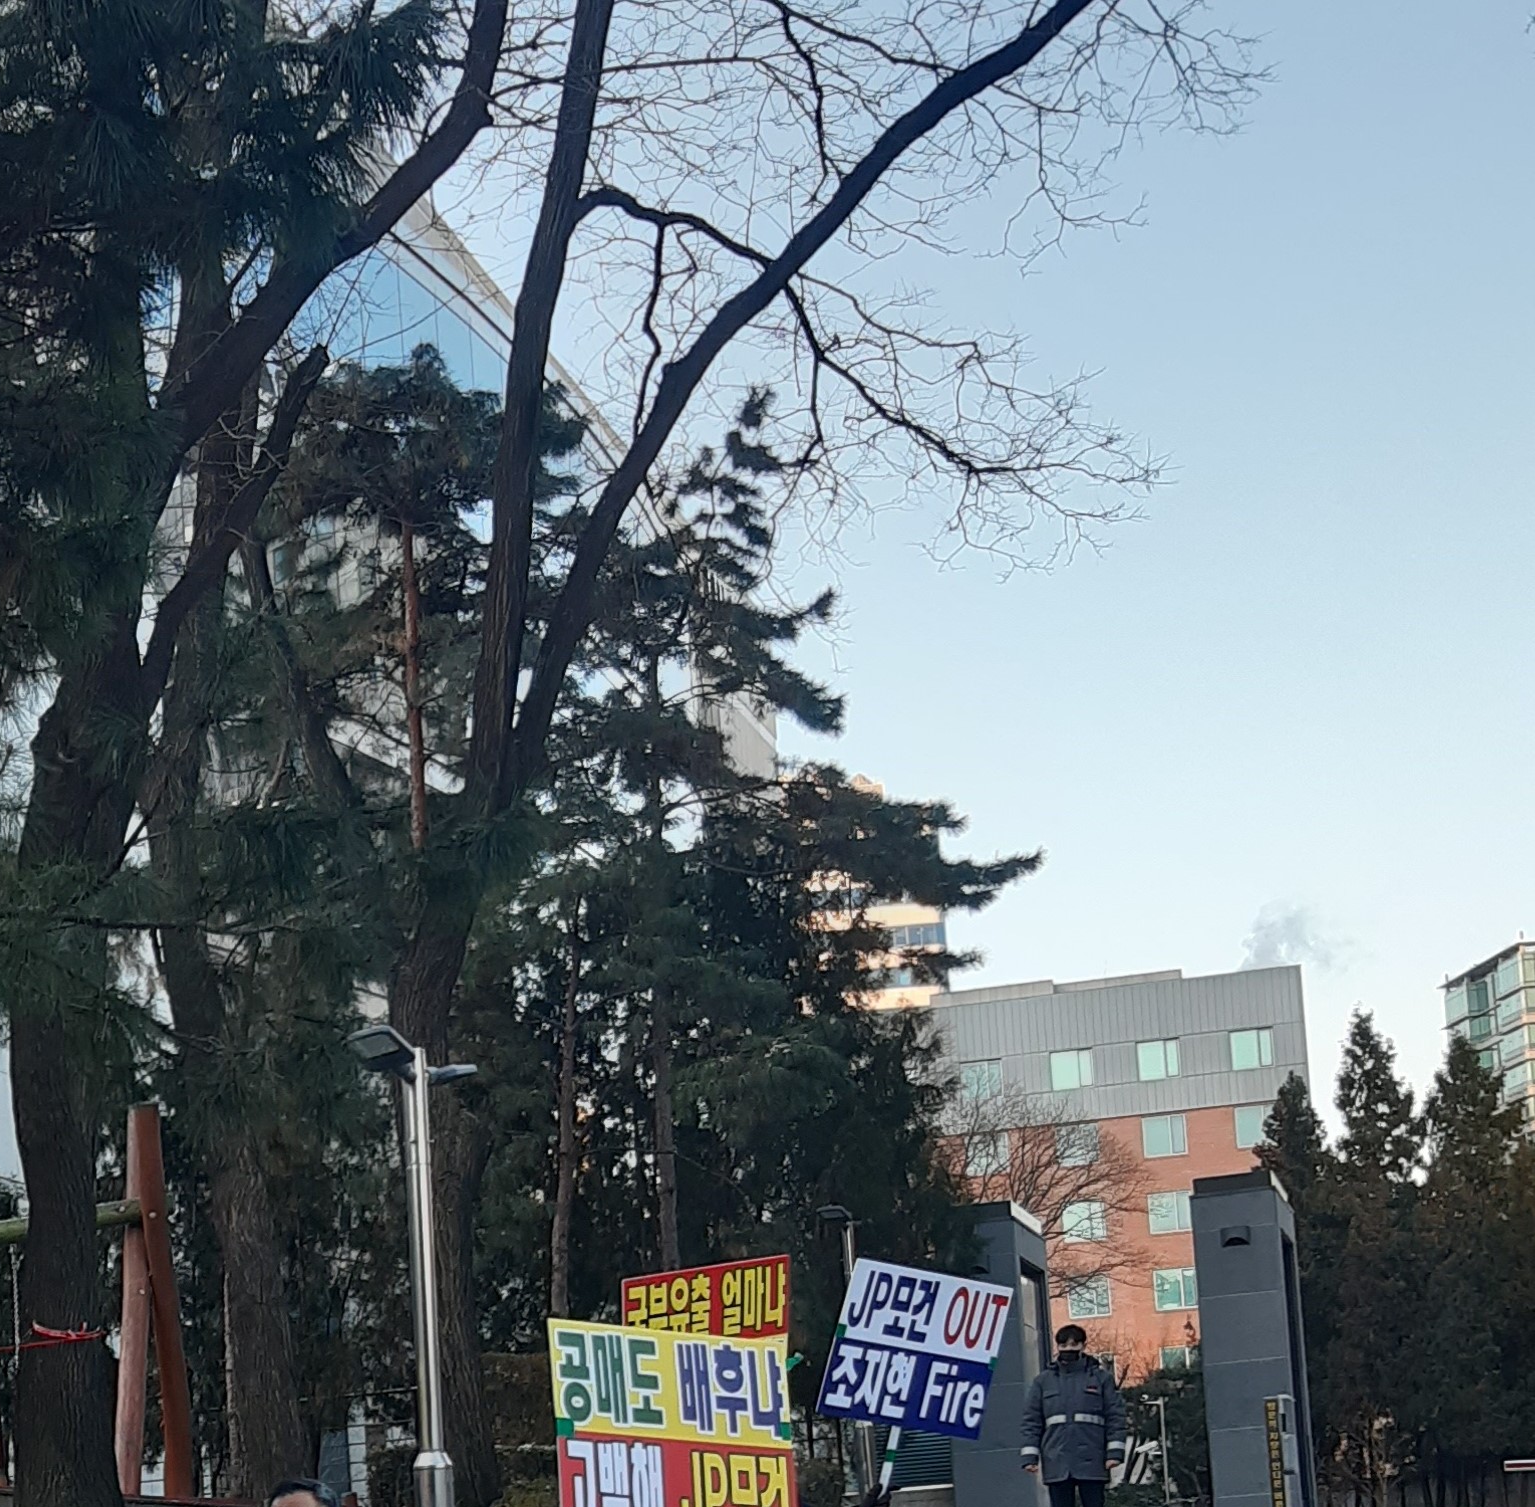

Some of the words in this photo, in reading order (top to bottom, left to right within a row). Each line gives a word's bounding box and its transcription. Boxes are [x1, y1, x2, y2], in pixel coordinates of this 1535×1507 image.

[847, 1269, 940, 1343] JP모건
[943, 1286, 1009, 1351] OUT
[555, 1330, 665, 1426] 공매도
[675, 1342, 787, 1437] 배후냐
[824, 1344, 918, 1420] 조지현
[918, 1360, 986, 1430] Fire
